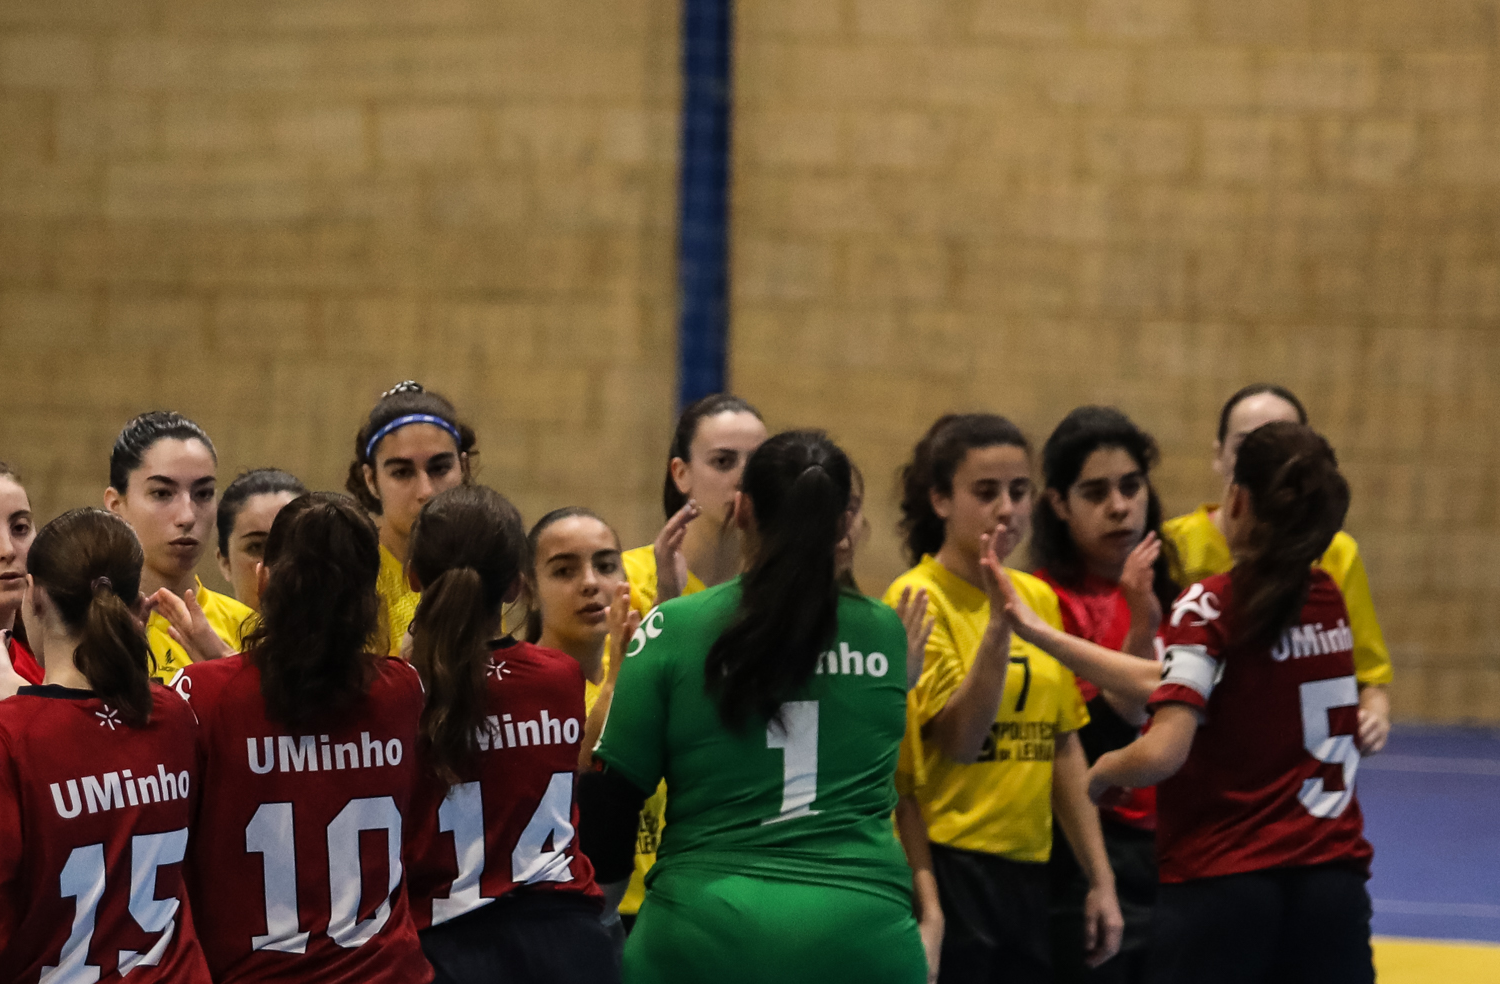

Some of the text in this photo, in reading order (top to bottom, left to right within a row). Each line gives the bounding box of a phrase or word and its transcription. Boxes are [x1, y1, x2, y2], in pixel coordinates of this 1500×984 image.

[50, 764, 190, 819] UMinho
[247, 731, 403, 775] UMinho
[476, 709, 580, 752] Minho
[761, 700, 824, 826] 1
[1299, 674, 1361, 819] 5
[245, 795, 404, 955] 10
[432, 771, 575, 926] 14
